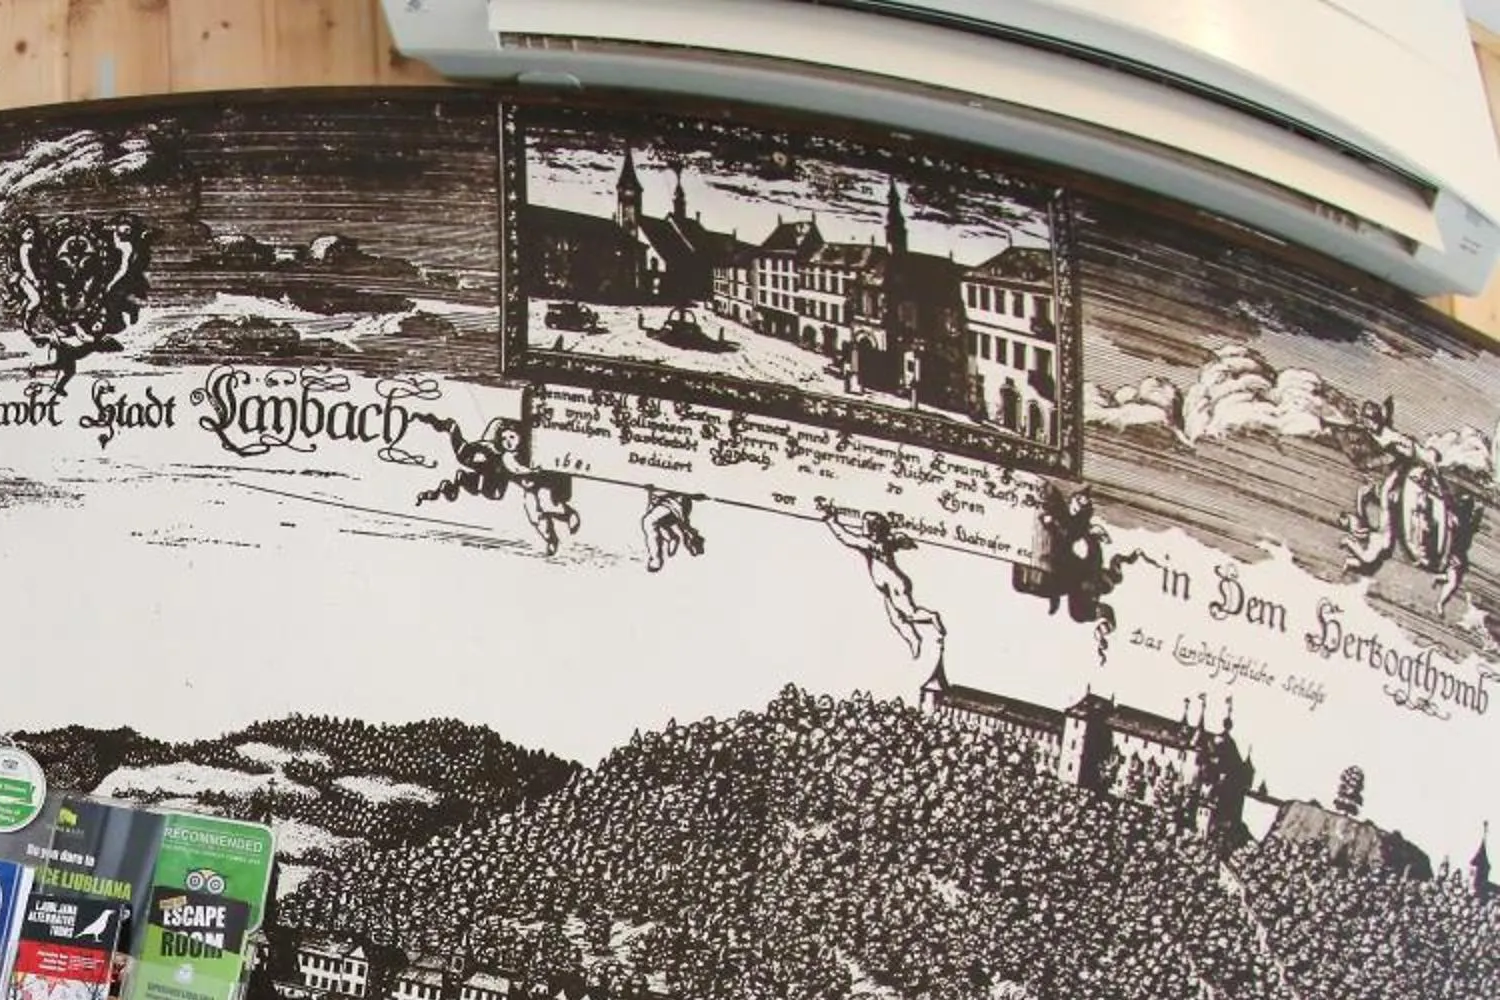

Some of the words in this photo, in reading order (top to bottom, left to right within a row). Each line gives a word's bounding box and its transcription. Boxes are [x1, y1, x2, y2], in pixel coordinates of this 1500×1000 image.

[1162, 554, 1191, 601] in
[1209, 564, 1287, 633] Dem
[1129, 628, 1163, 651] Das
[163, 826, 263, 853] RECOMMENDED
[61, 872, 133, 900] LJUBLJANA
[163, 905, 227, 928] ESCAPE
[161, 931, 225, 959] ROOM
